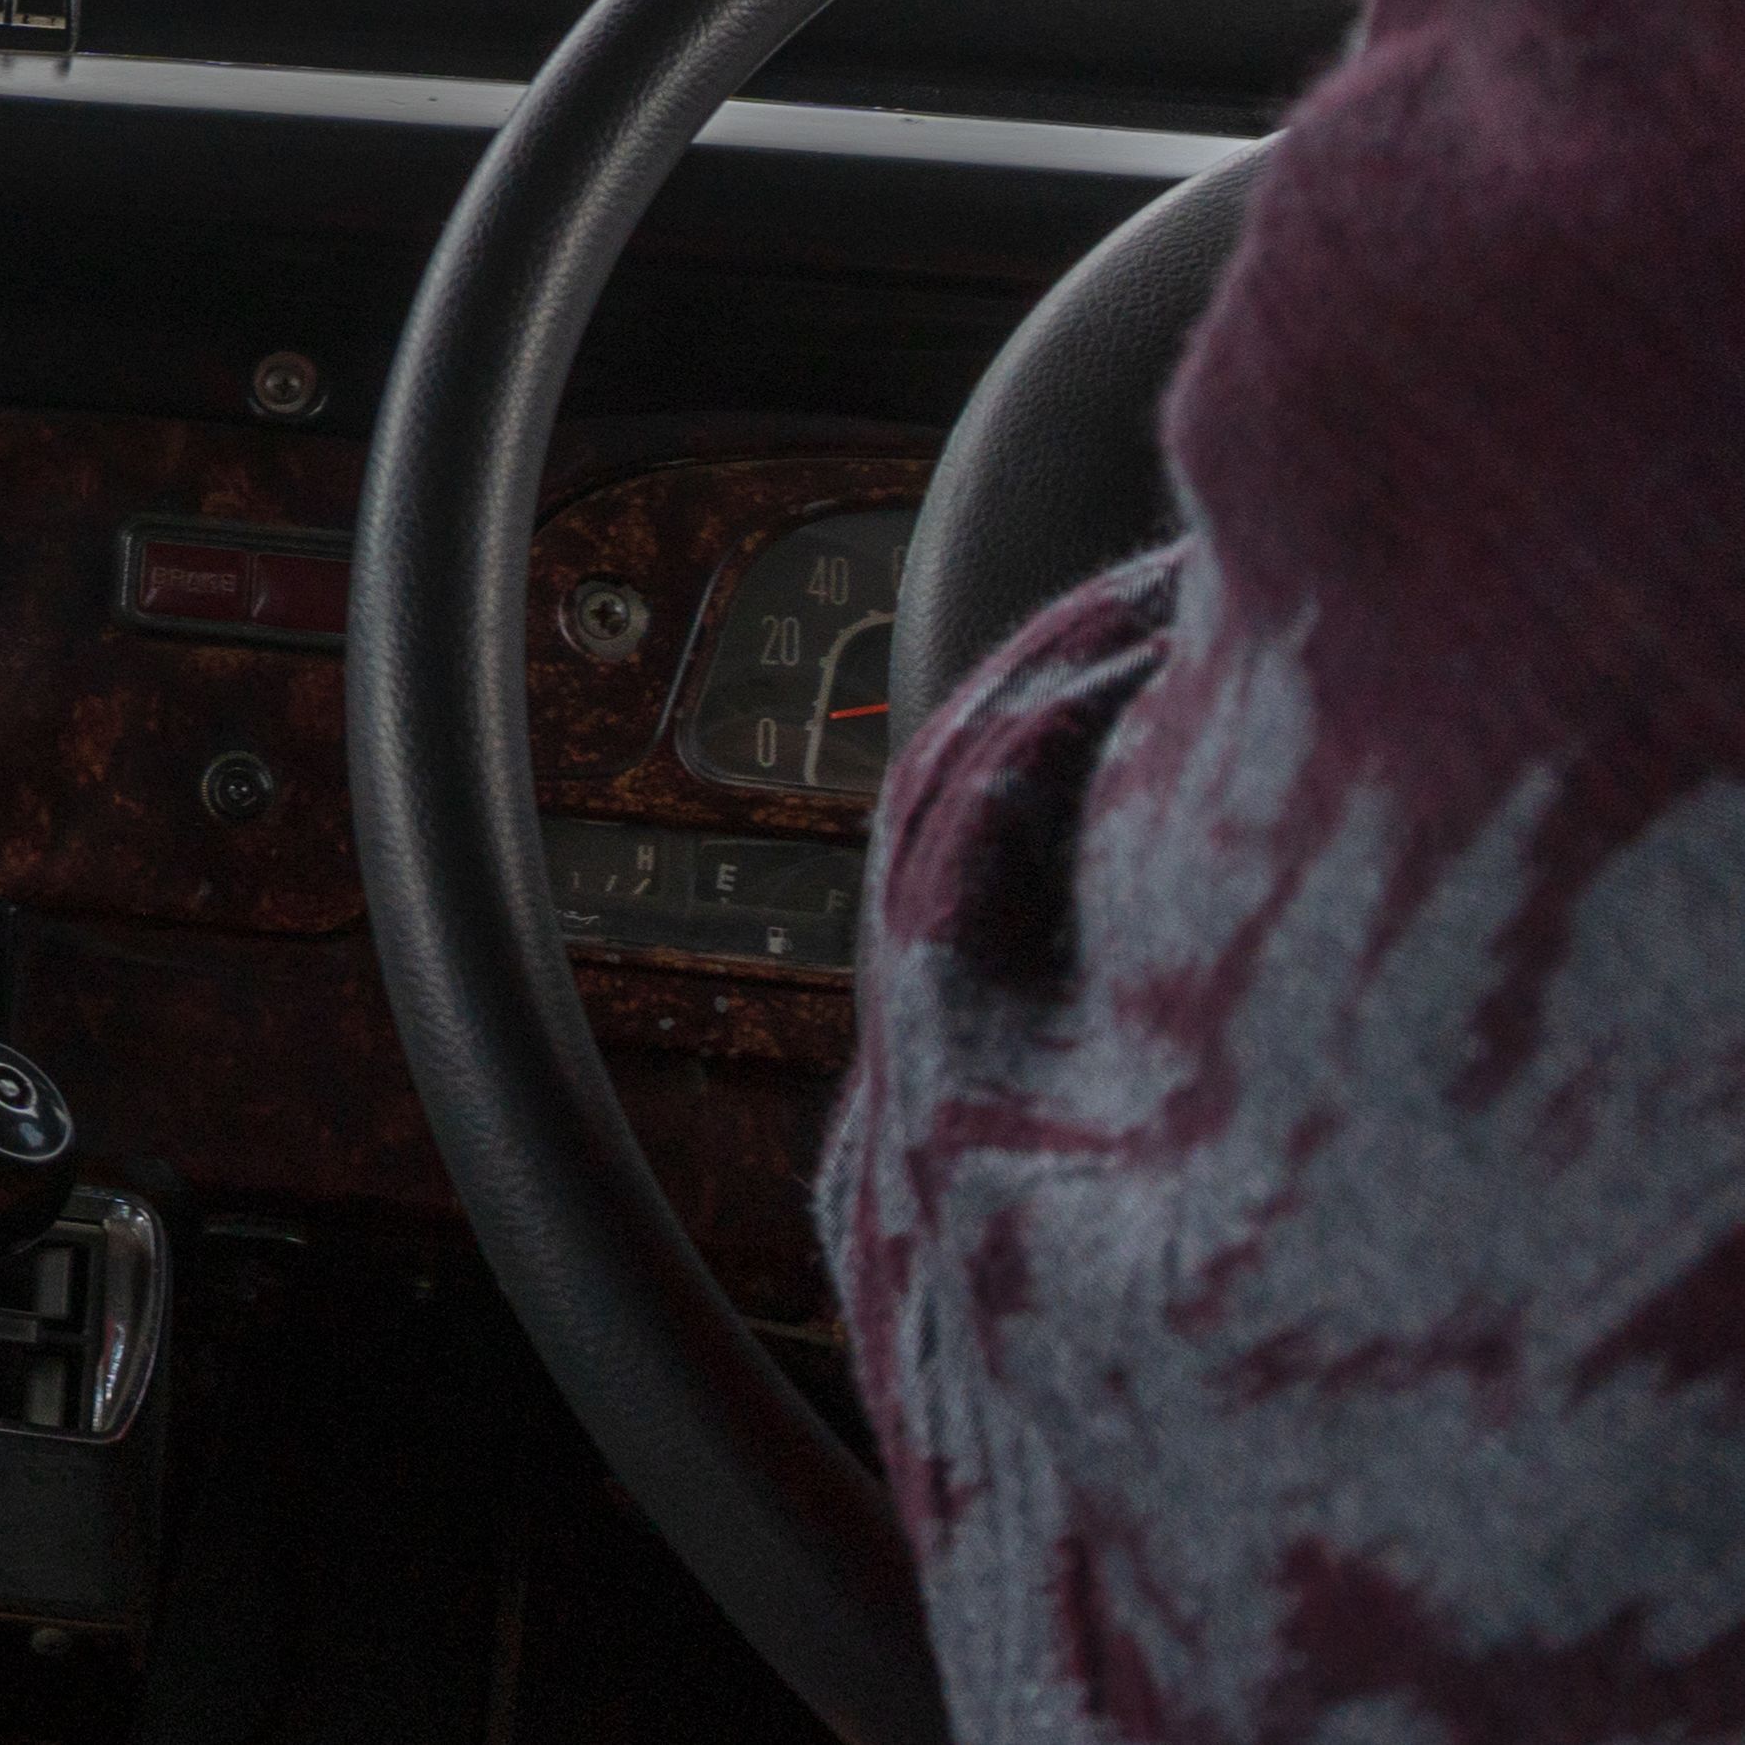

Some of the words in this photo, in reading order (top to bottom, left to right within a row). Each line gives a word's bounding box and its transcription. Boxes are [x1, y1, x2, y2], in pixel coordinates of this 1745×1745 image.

[808, 556, 850, 606] 40
[761, 614, 800, 667] 20
[758, 717, 777, 768] 0
[636, 844, 655, 871] H
[716, 862, 738, 892] E
